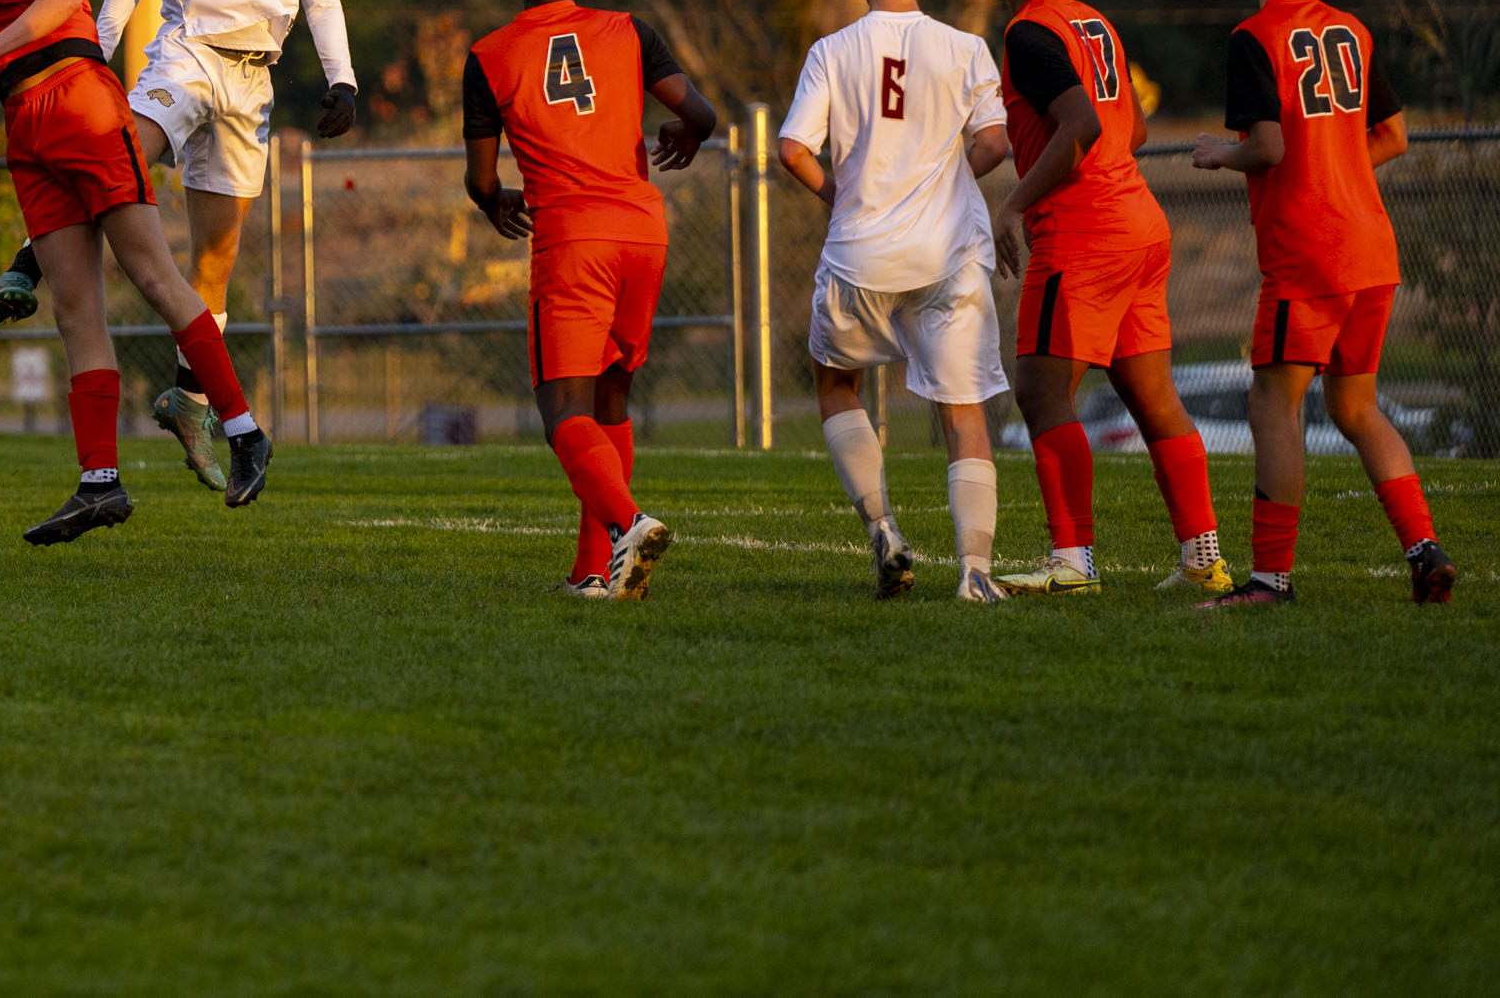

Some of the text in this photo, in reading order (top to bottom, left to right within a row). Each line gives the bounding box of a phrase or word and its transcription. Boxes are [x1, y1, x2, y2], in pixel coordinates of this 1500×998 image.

[543, 33, 596, 115] 4
[882, 56, 906, 120] 6
[1069, 19, 1119, 101] 17
[1288, 25, 1363, 118] 20
